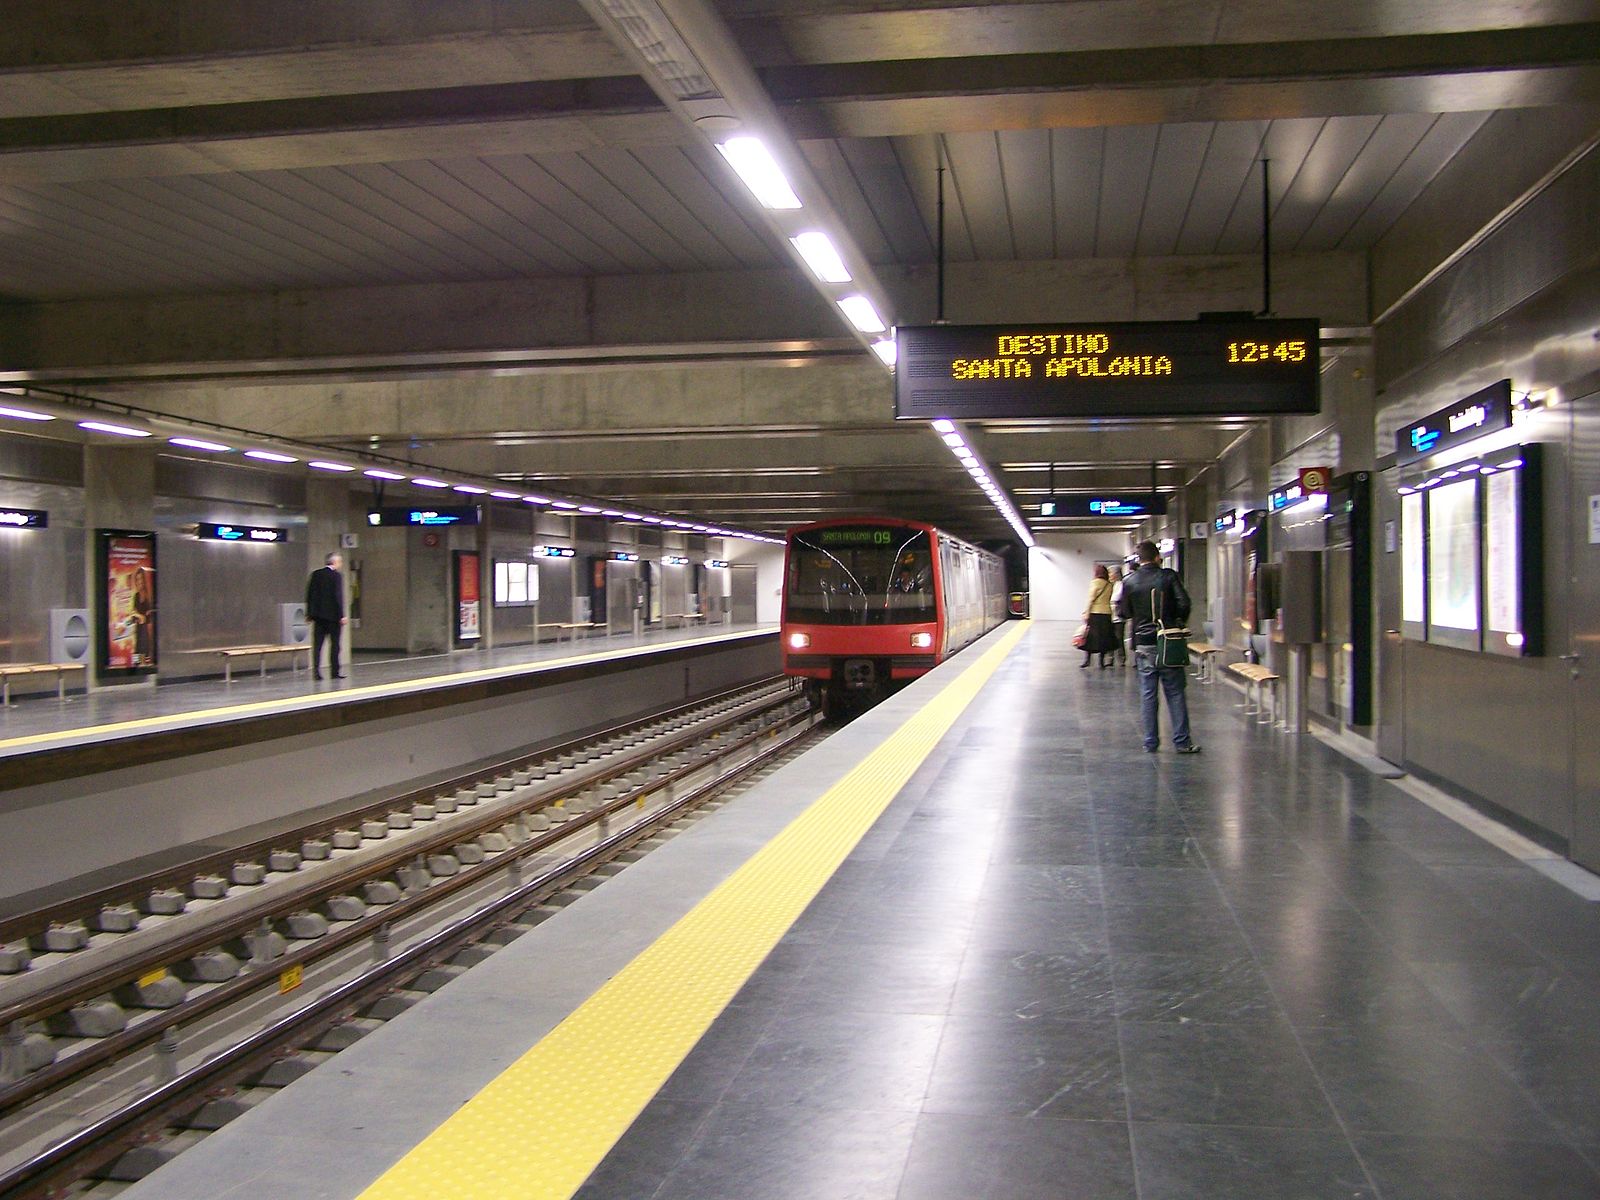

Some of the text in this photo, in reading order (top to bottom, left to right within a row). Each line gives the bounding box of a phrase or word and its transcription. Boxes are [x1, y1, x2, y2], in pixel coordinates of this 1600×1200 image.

[998, 333, 1110, 356] DESTINO
[1227, 341, 1306, 363] 12:45
[951, 358, 1032, 380] SANTA
[873, 530, 891, 544] 09
